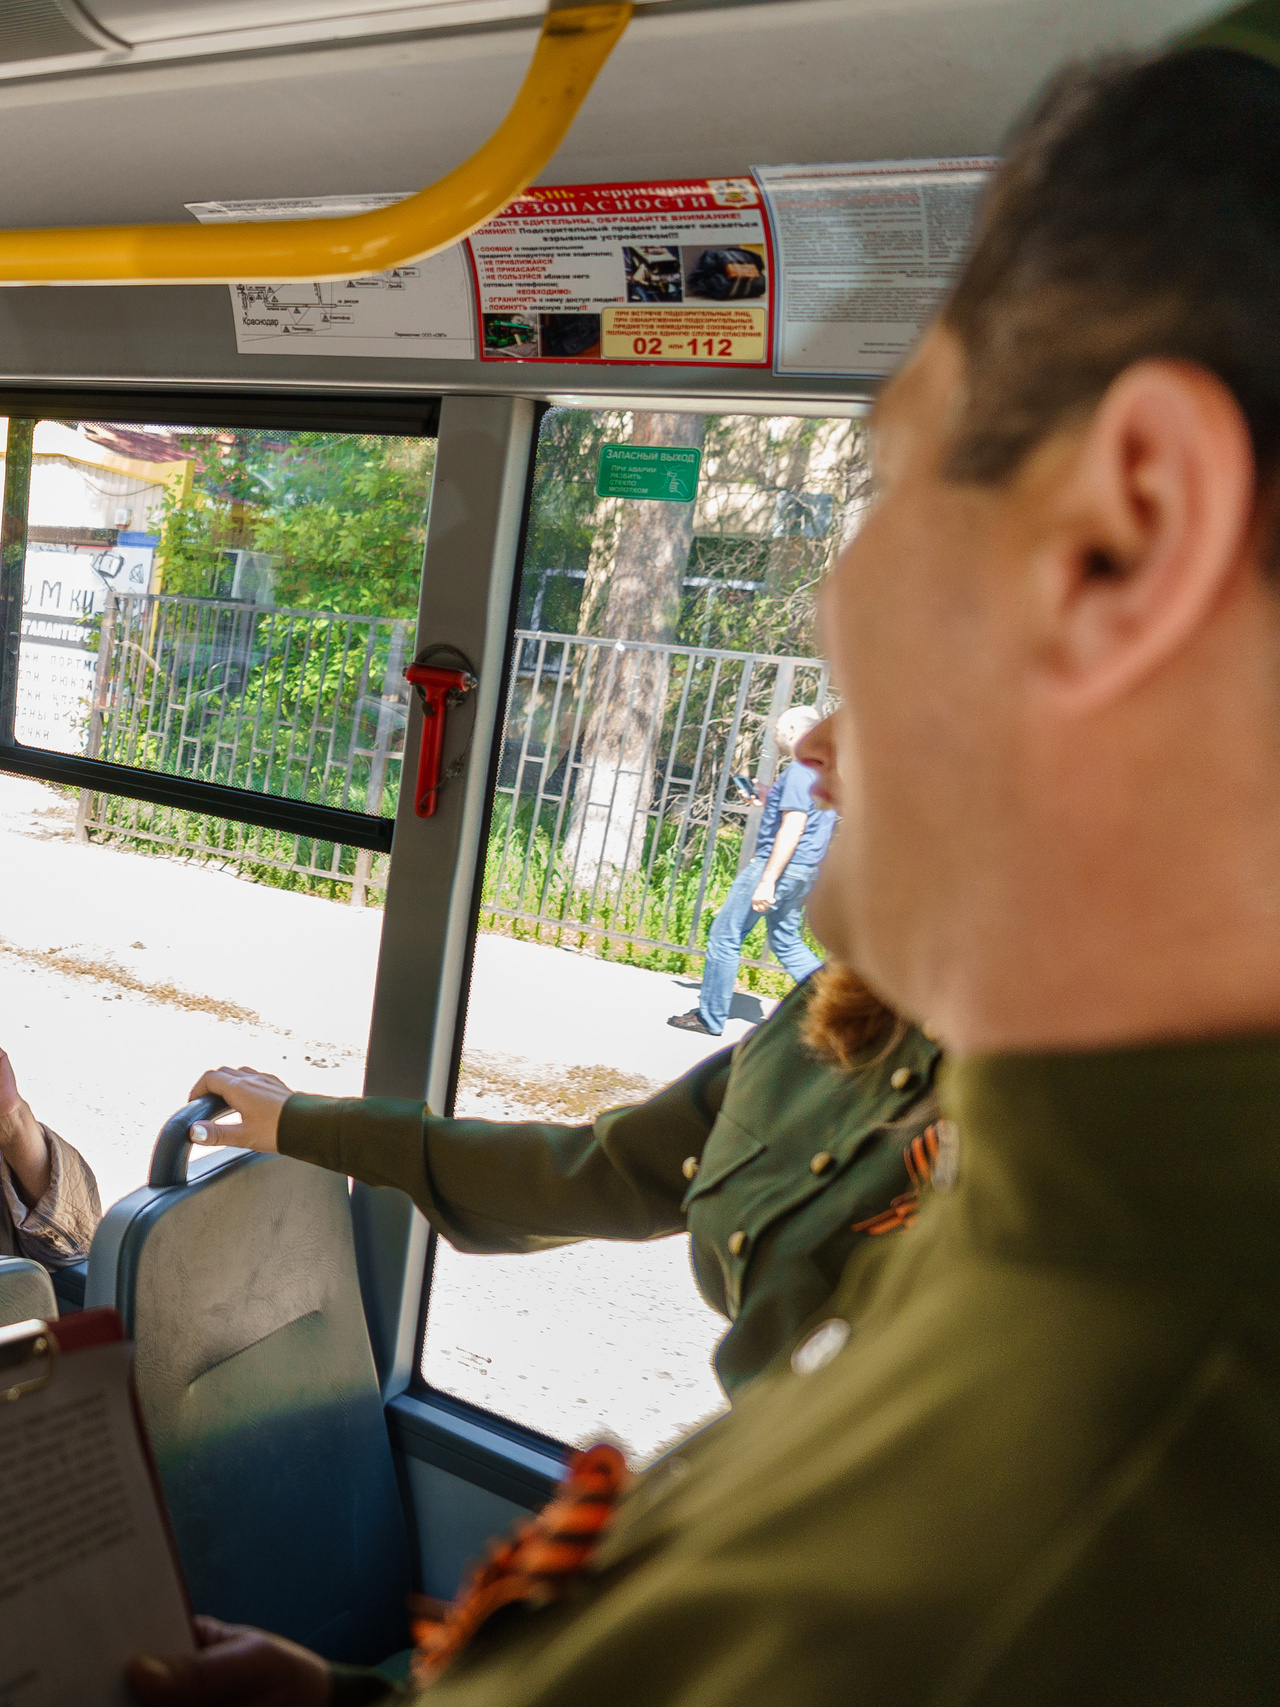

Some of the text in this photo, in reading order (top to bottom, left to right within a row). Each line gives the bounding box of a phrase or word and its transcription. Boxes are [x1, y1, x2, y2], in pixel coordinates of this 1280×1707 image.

[483, 220, 520, 228] УДЬТЕ
[597, 213, 669, 223] ОБРАЩАЙТЕ
[671, 212, 741, 221] ВНИМАНИЕ!
[519, 226, 608, 235] Подозрительный
[611, 225, 657, 233] предмет
[243, 316, 279, 327] Краснодар
[633, 337, 662, 355] 02
[687, 338, 732, 356] 112
[606, 449, 695, 463] ЗАПАСНЫЙ ВЫХОД
[50, 655, 97, 672] ПОРТМО
[51, 675, 92, 691] РЮКЗА
